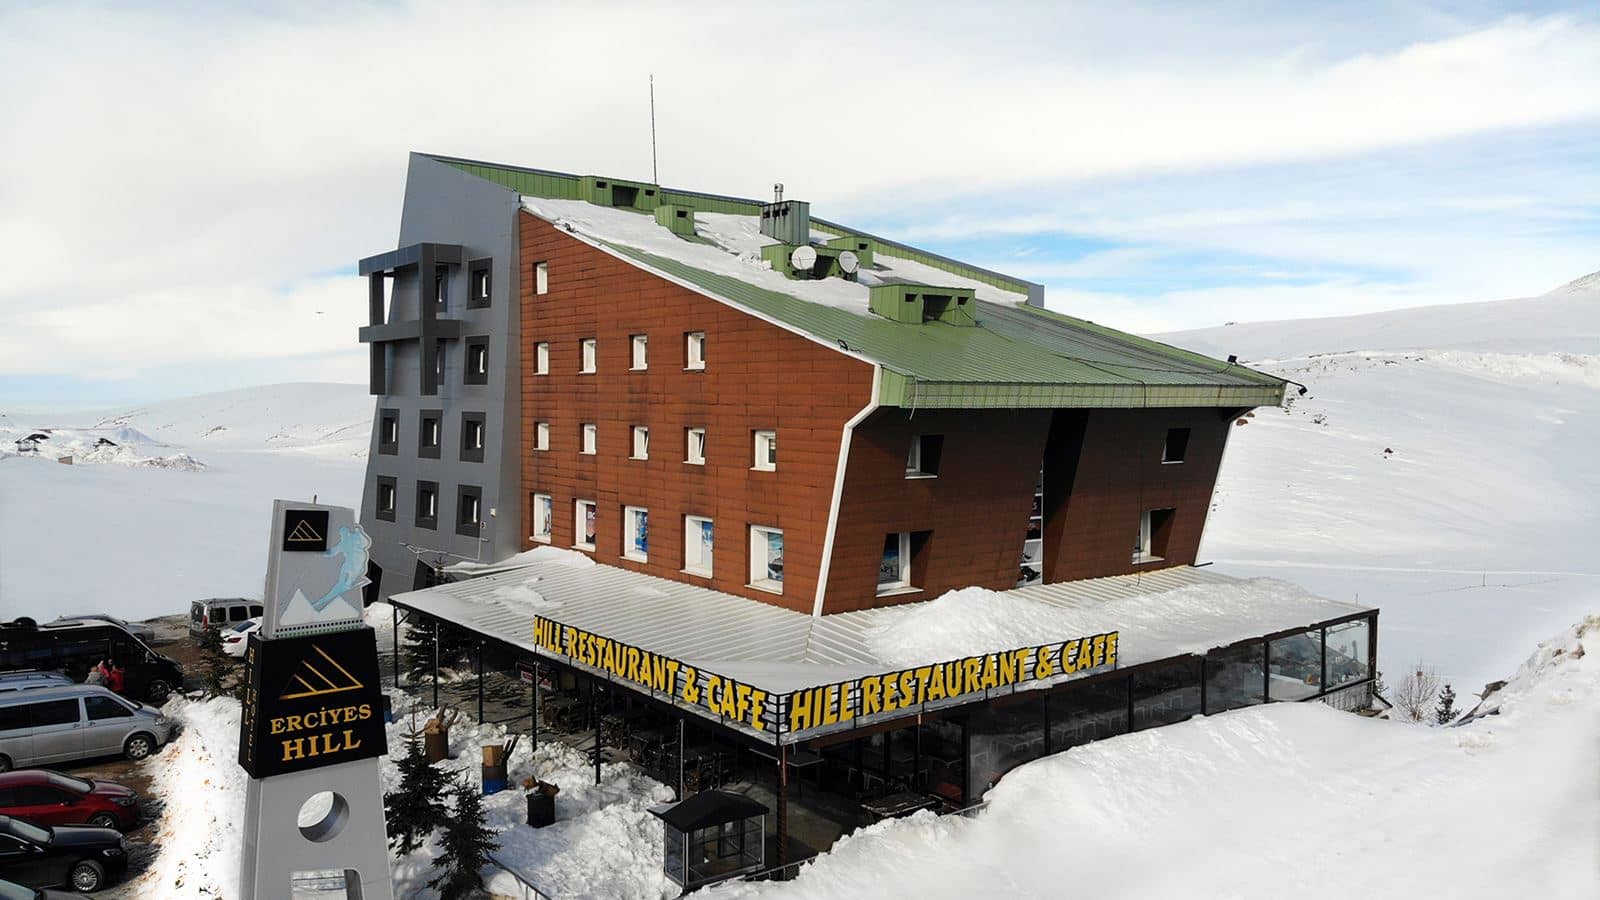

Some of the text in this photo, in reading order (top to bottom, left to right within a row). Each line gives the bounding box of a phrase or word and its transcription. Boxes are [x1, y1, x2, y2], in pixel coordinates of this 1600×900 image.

[533, 616, 563, 655] HILL
[567, 626, 679, 695] RESTAURANT
[682, 667, 700, 704] &
[706, 675, 768, 731] CAFE
[790, 632, 1119, 732] HILL RESTAURANT & CAFE
[281, 729, 362, 761] HILL
